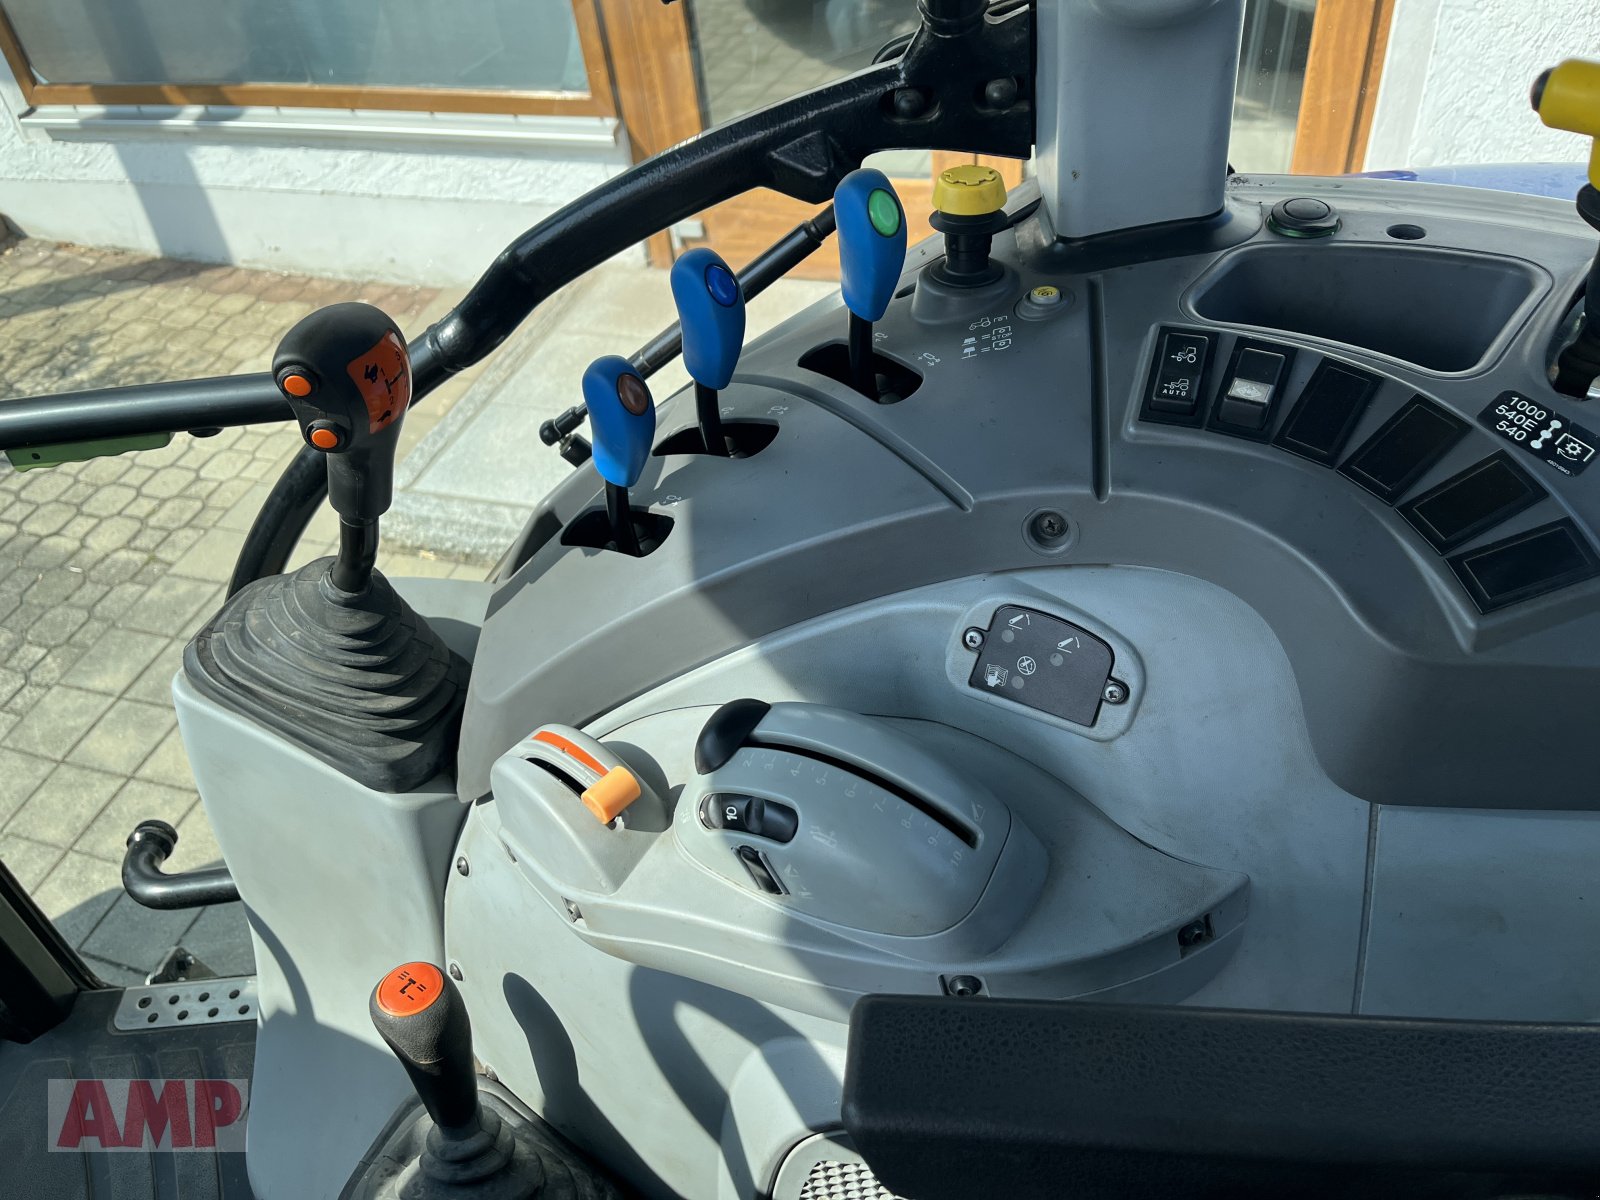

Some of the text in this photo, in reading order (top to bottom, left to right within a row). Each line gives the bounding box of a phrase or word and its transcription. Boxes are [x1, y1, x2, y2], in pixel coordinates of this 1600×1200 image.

[1162, 389, 1186, 397] AUTO
[1495, 404, 1538, 432] 540E
[1510, 396, 1547, 421] 1000
[1496, 420, 1527, 441] 540
[726, 806, 738, 821] 10
